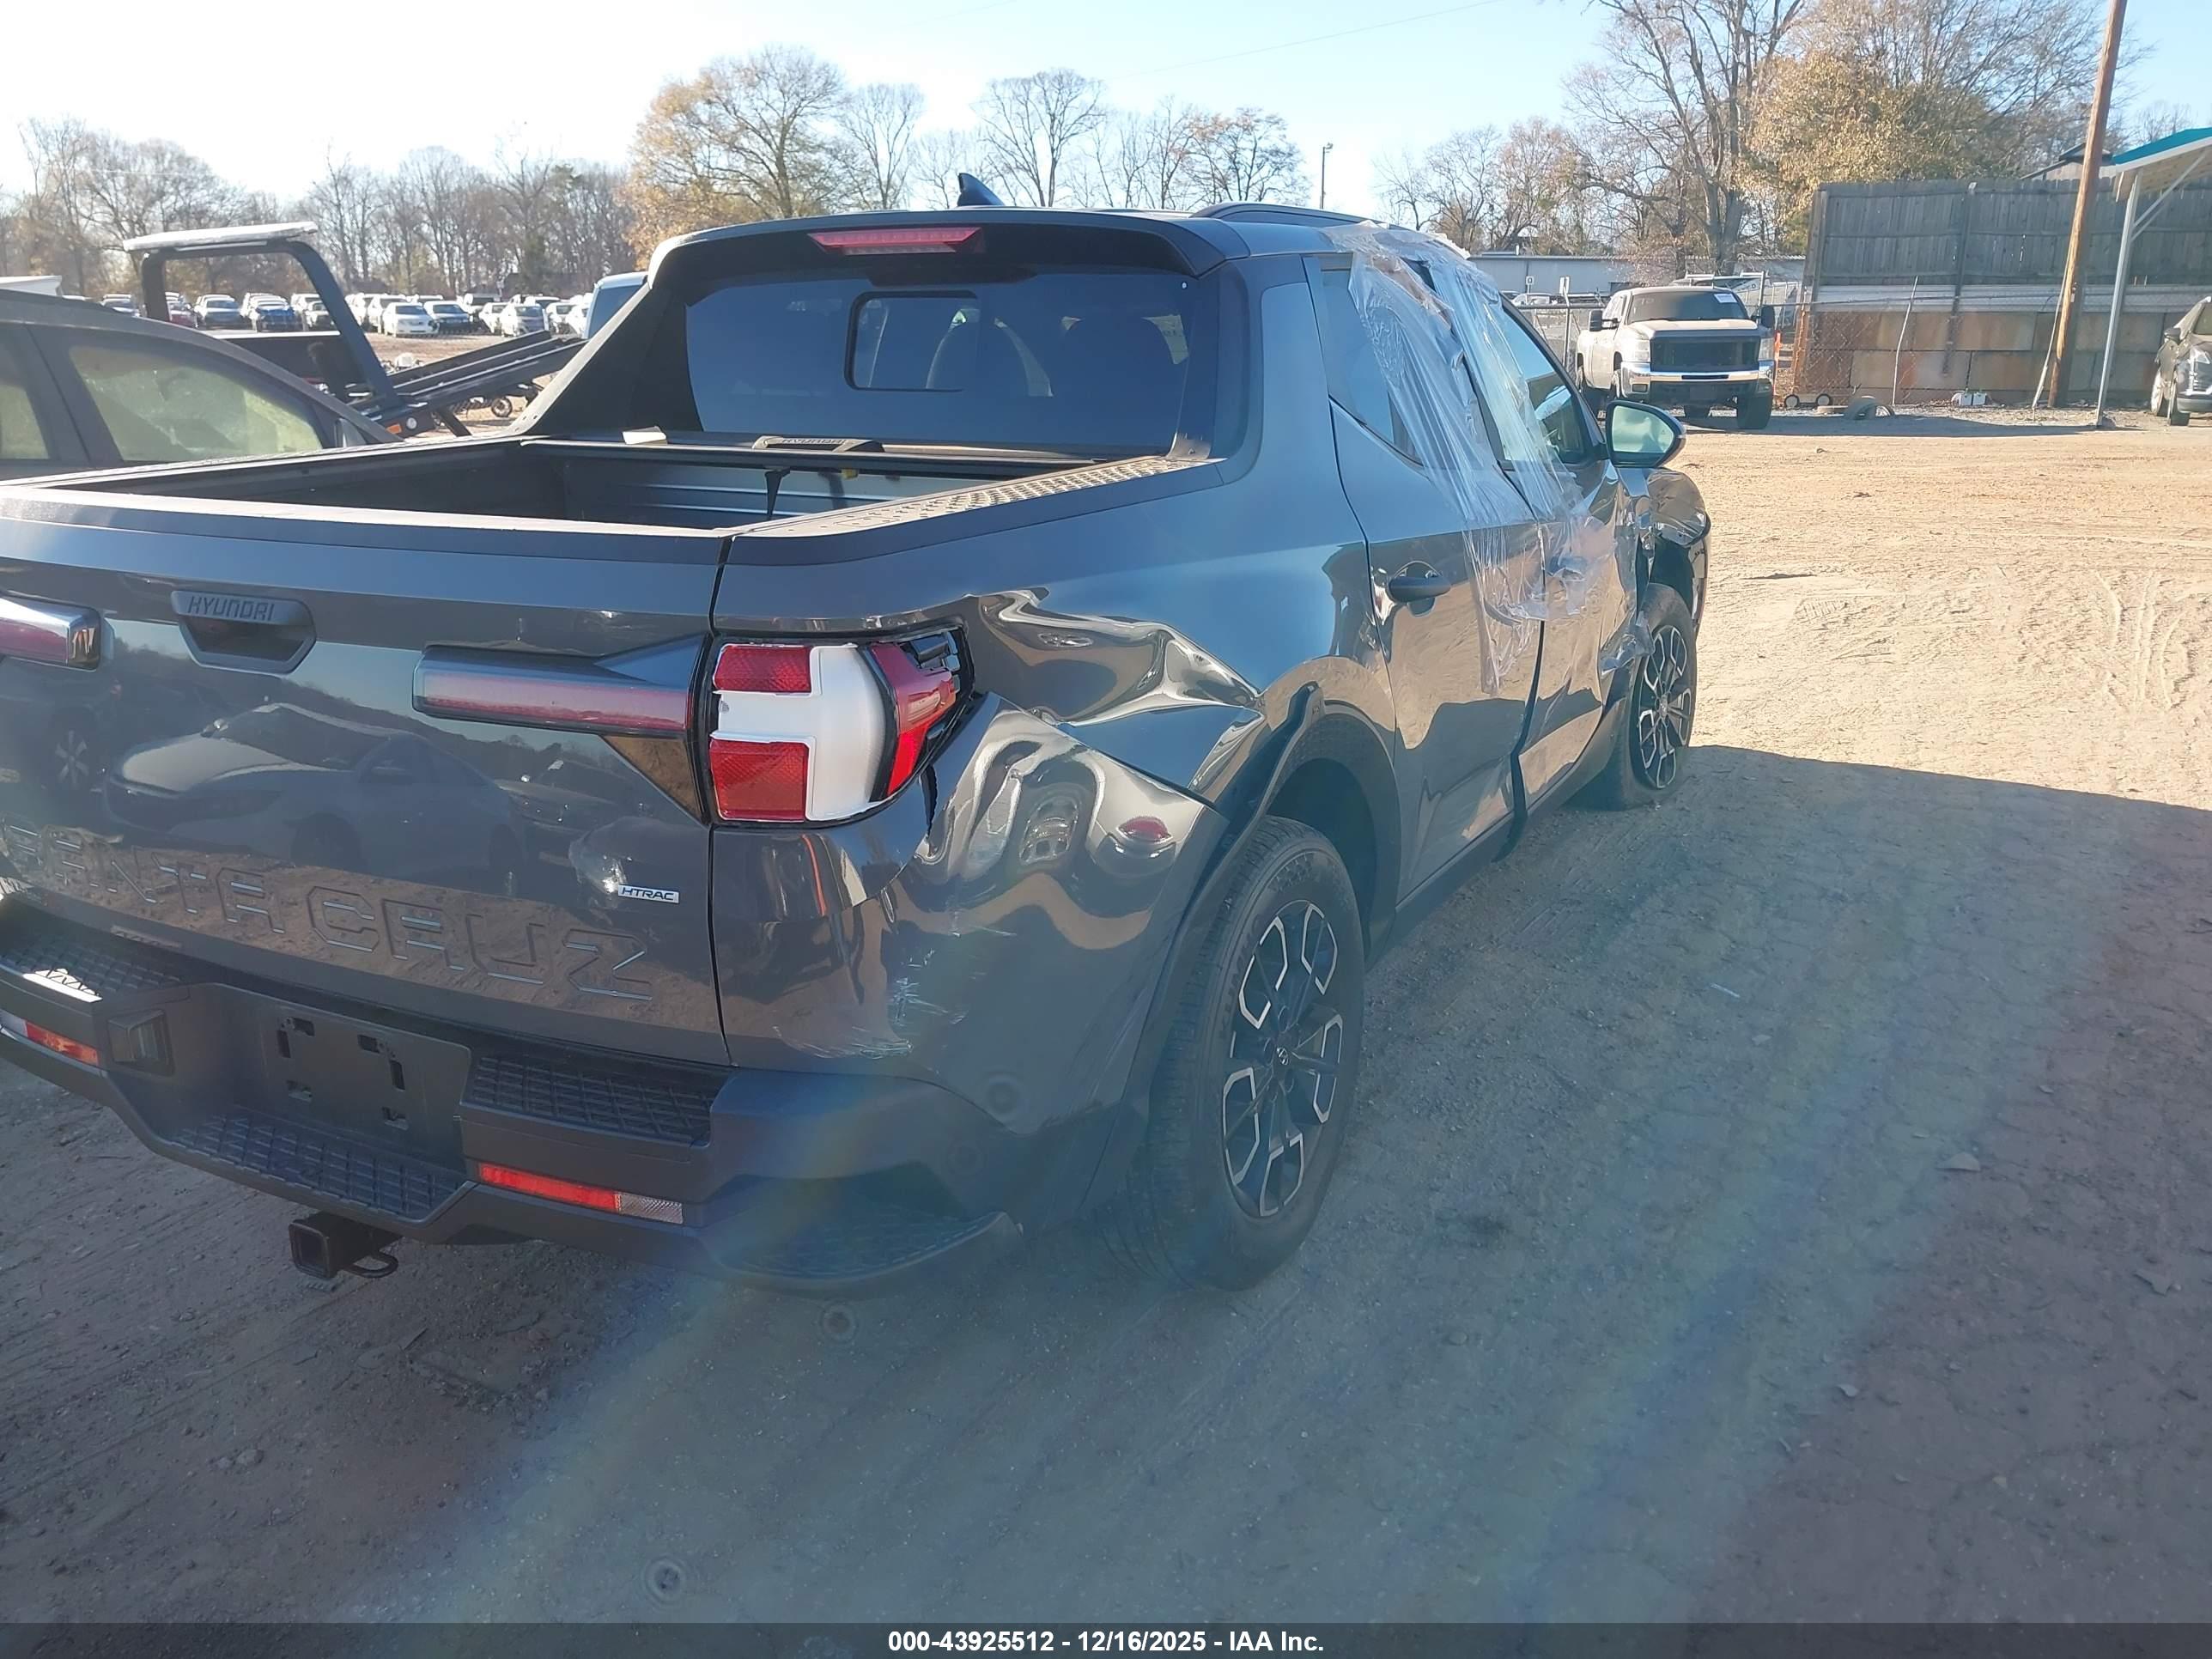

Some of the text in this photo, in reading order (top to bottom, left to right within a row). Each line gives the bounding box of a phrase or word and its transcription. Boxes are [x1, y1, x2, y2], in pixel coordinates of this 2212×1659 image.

[187, 595, 275, 622] HYUNDAI
[622, 886, 675, 901] HTRAC
[306, 884, 653, 1002] CRUZ
